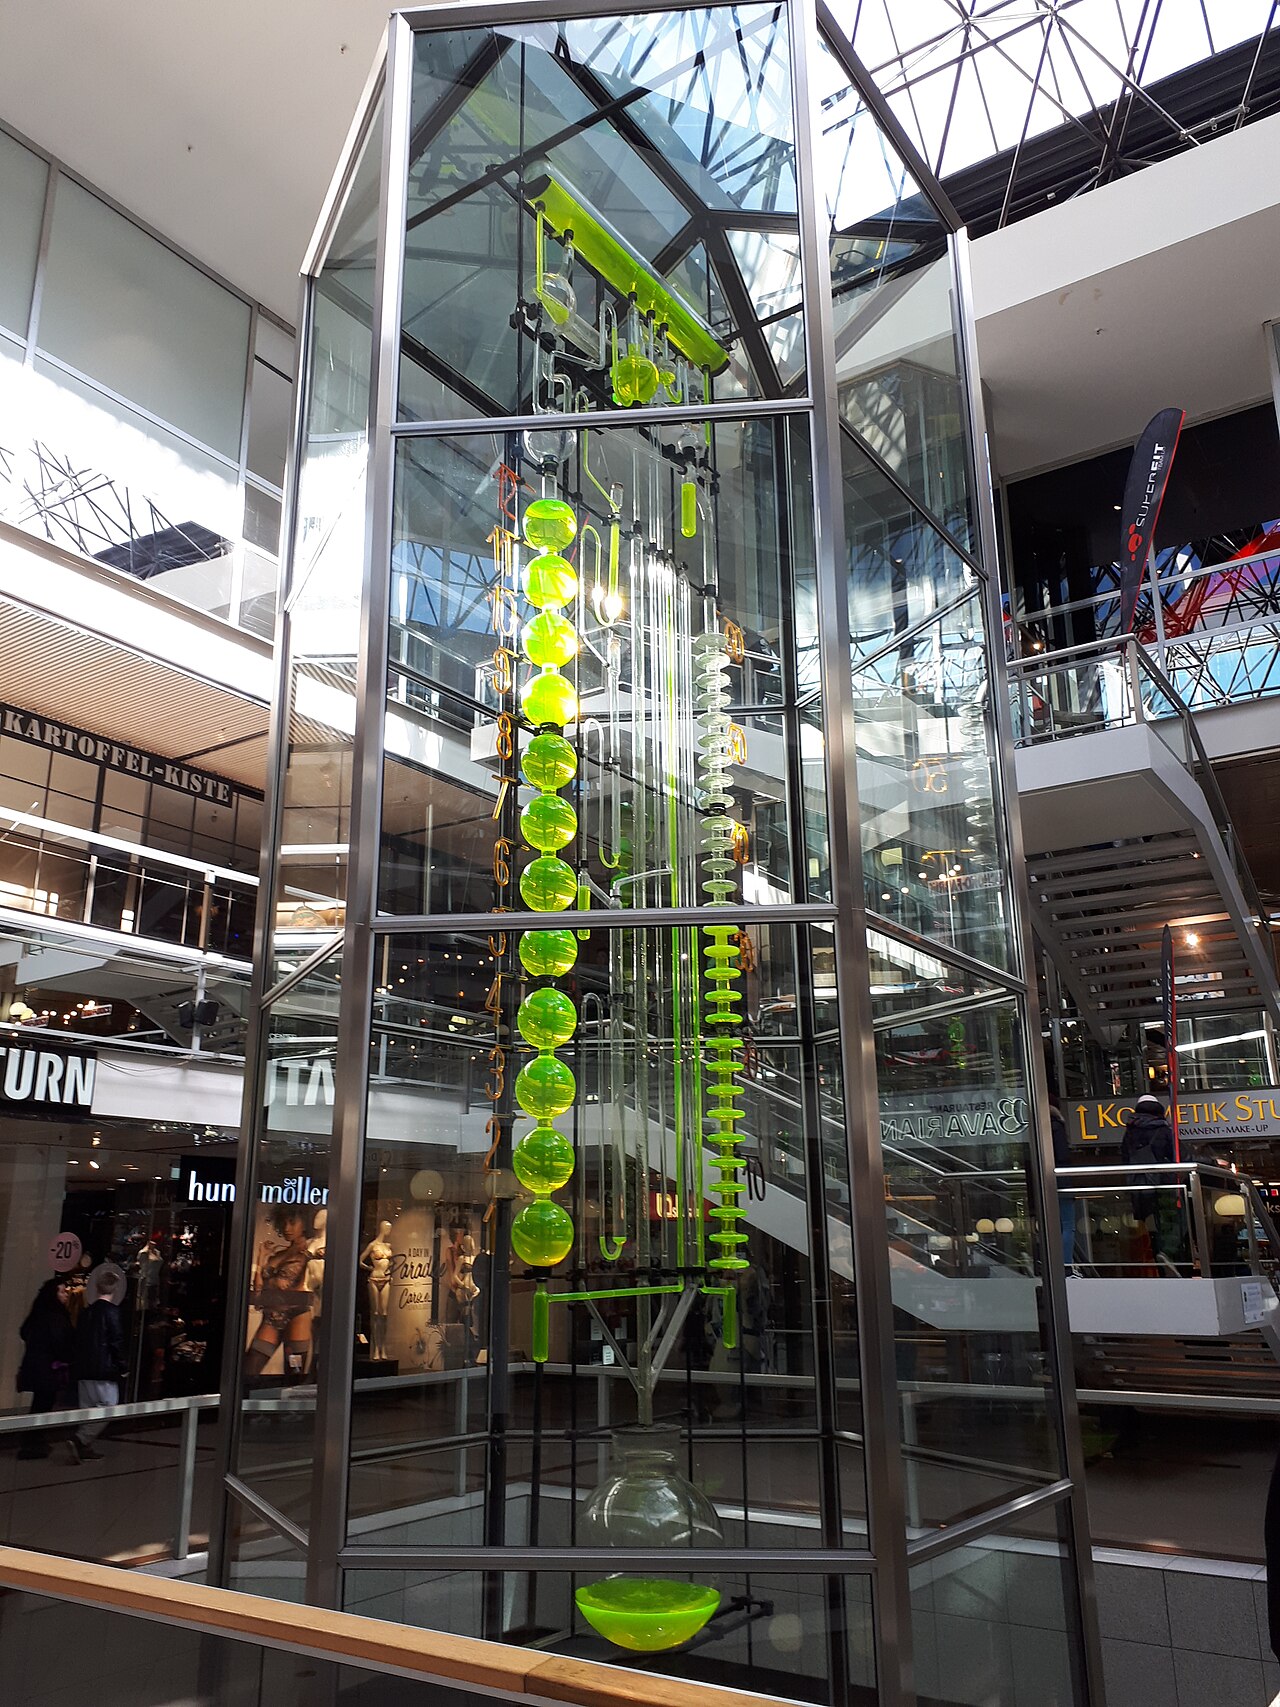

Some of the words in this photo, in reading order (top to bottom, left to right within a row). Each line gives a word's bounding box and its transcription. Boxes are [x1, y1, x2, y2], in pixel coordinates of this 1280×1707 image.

[1135, 443, 1164, 527] SUPERFIT
[3, 709, 230, 802] KARTOFFEL-KISTE
[0, 1047, 97, 1106] URN
[1097, 1102, 1230, 1129] KOETIK
[384, 1253, 447, 1280] Parade
